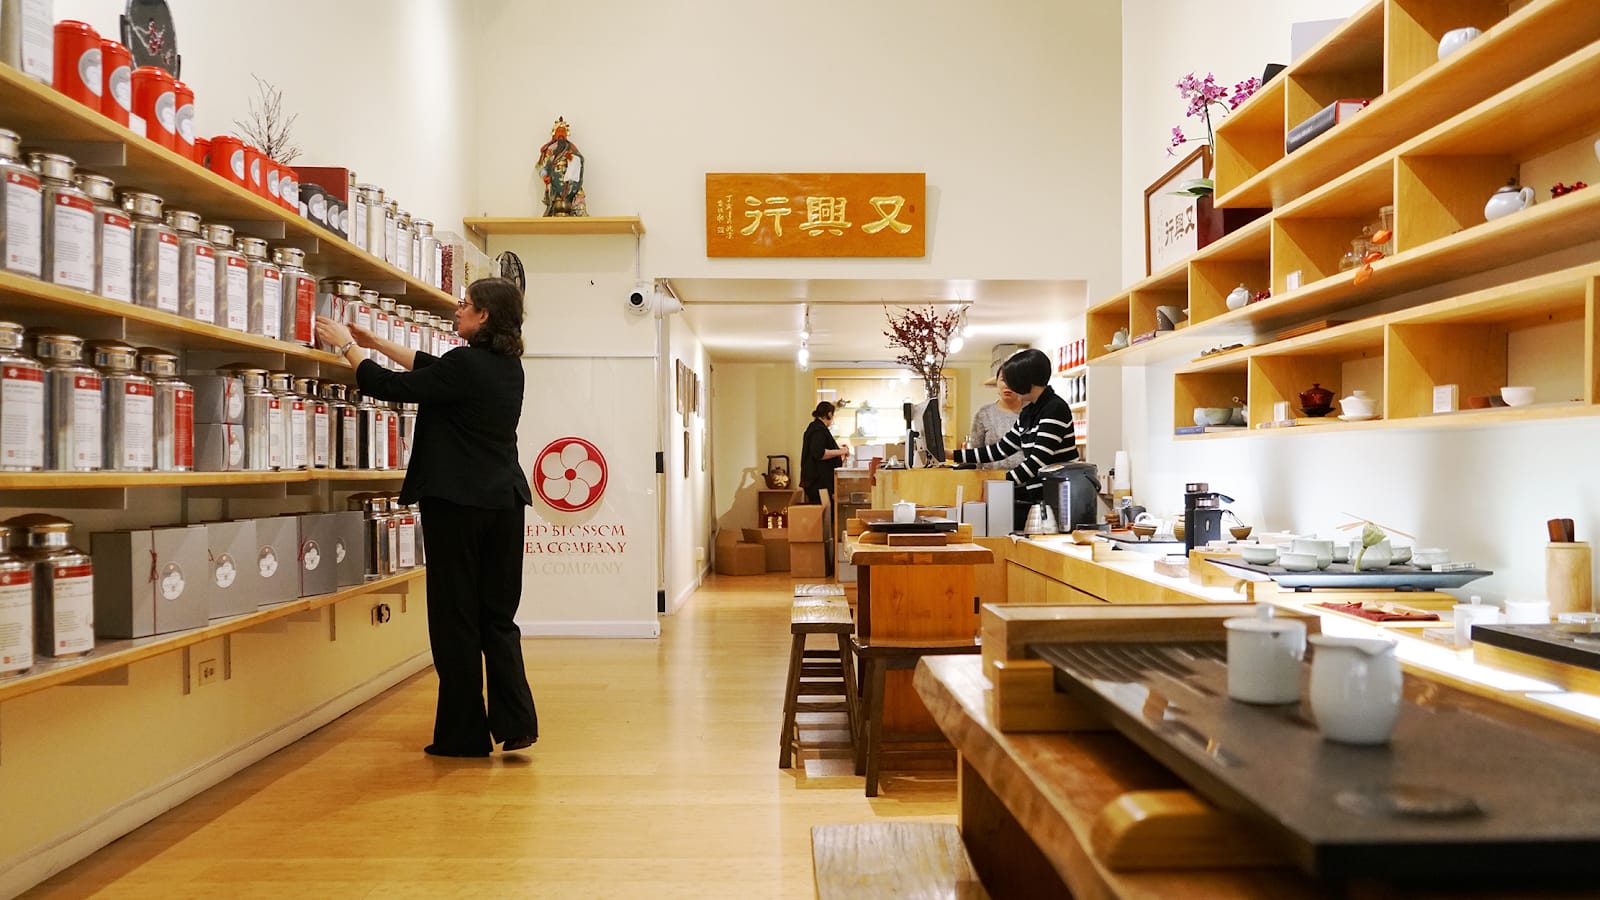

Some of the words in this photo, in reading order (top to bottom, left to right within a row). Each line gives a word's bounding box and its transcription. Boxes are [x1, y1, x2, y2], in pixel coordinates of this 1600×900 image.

[526, 525, 547, 537] ED
[552, 525, 625, 537] BLOSSOM
[525, 542, 543, 554] EA
[547, 542, 626, 554] COMPANY
